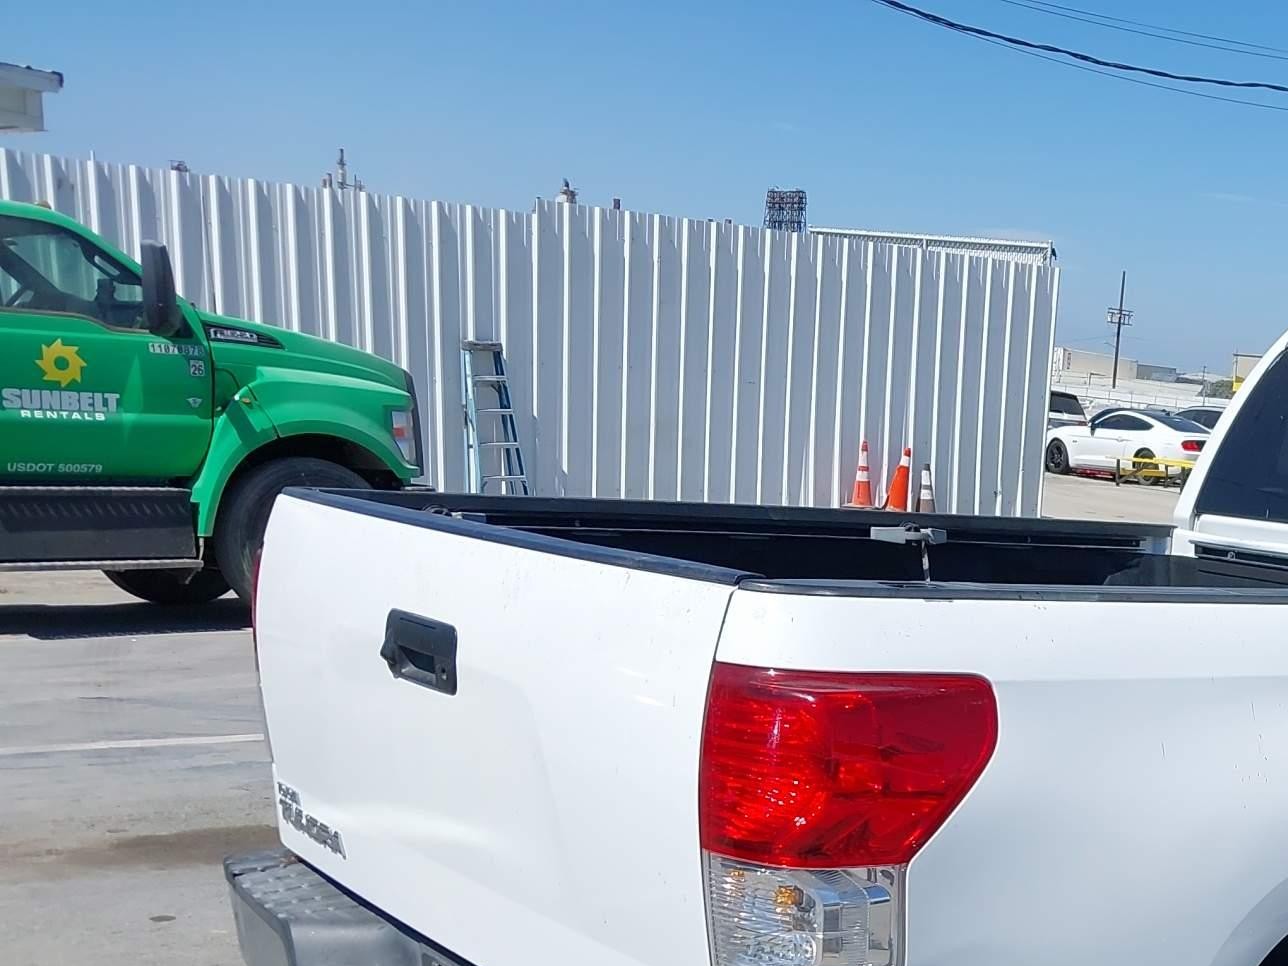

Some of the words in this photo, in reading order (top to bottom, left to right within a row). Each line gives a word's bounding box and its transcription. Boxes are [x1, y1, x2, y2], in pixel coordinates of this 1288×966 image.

[191, 364, 204, 376] 26
[1, 388, 120, 411] SUNBELT
[20, 410, 107, 421] RENTALS
[7, 462, 54, 473] USDOT
[58, 463, 103, 473] 500579
